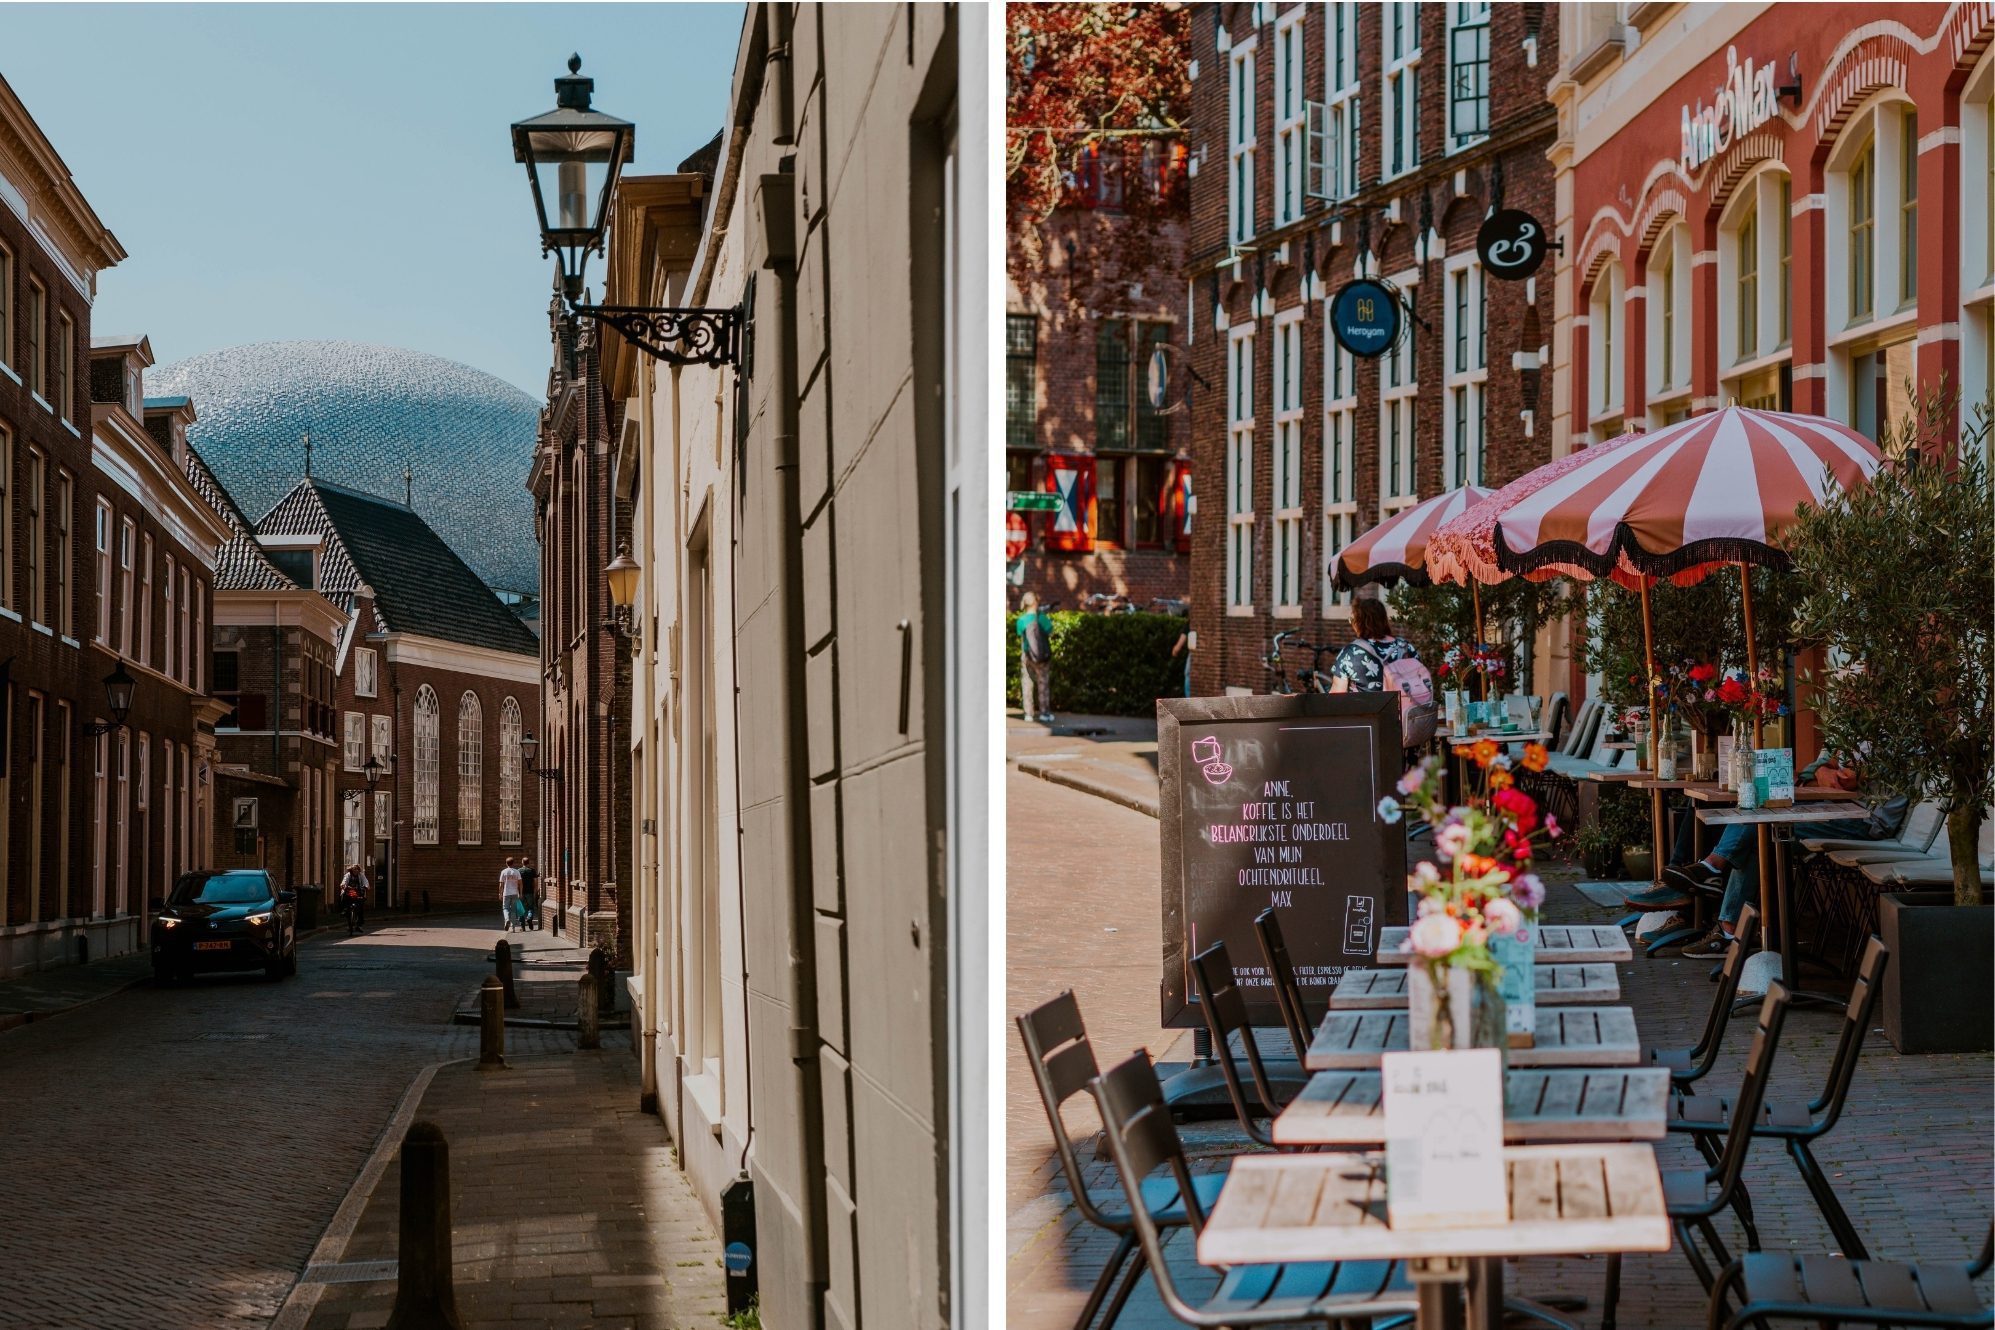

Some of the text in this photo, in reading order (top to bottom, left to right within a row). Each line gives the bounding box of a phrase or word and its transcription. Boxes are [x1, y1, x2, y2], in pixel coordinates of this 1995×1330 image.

[1242, 801, 1315, 820] KOFFIE IS HET
[1211, 823, 1351, 843] BELANGRIJKSTE ONDERDEEL
[1254, 846, 1302, 864] VAN MIJN
[1271, 890, 1292, 908] MAX
